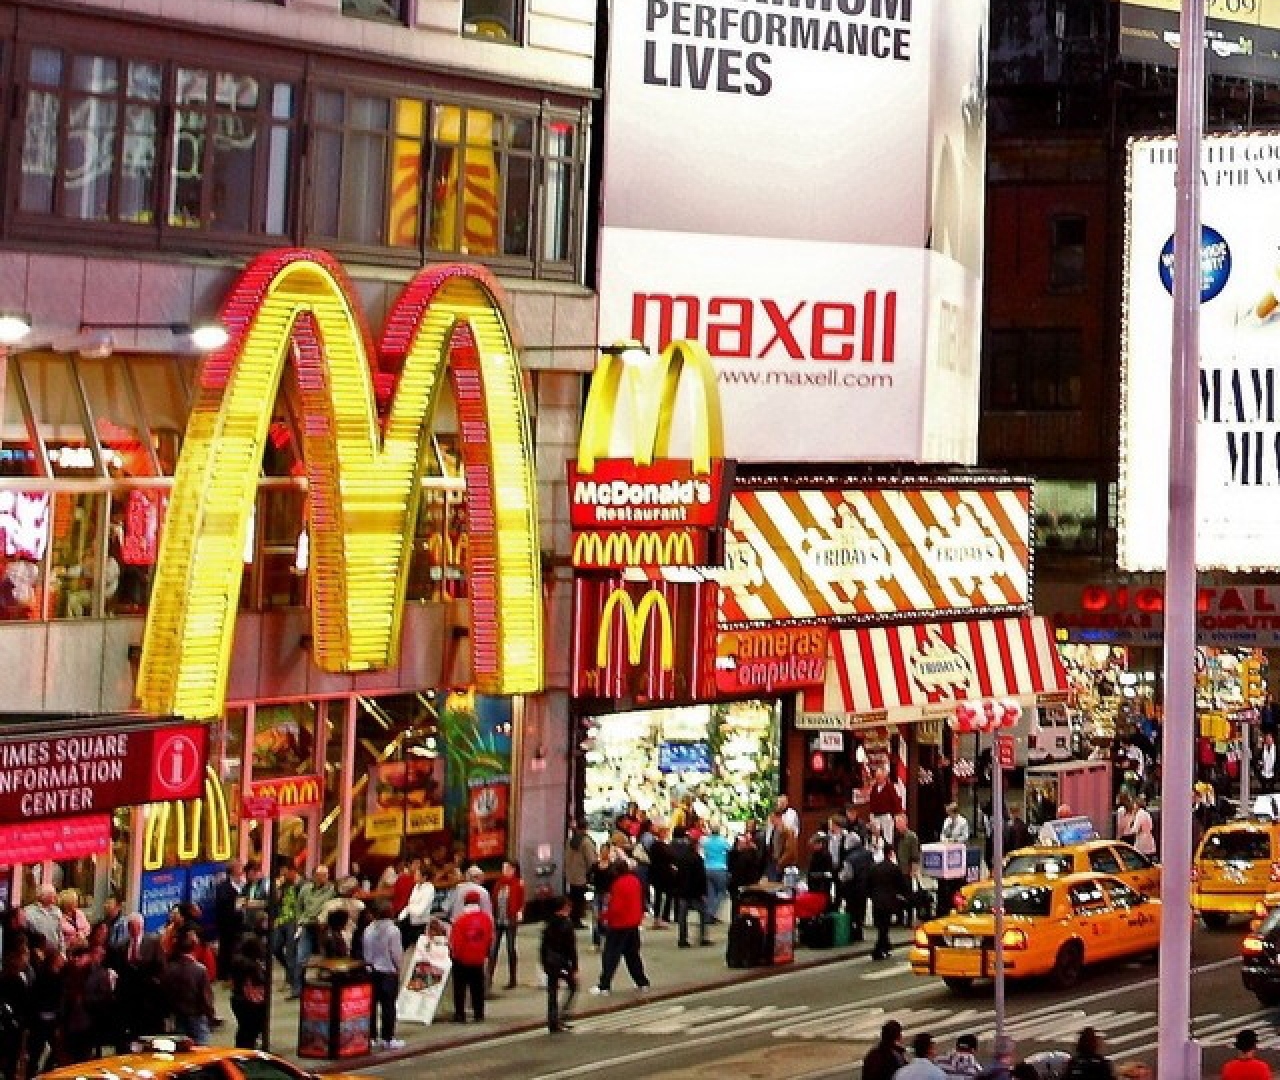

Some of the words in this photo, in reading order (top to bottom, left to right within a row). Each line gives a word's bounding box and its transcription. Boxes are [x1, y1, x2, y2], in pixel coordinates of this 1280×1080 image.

[643, 42, 773, 97] LIVES
[632, 288, 897, 365] maxell
[716, 367, 894, 391] ww.maxell.com
[574, 478, 712, 506] McDonald's
[595, 505, 688, 522] Restaurant
[1082, 587, 1276, 613] DIGTAL
[56, 733, 129, 765] SQUARE
[823, 734, 842, 748] ATM
[21, 786, 93, 816] CENTER
